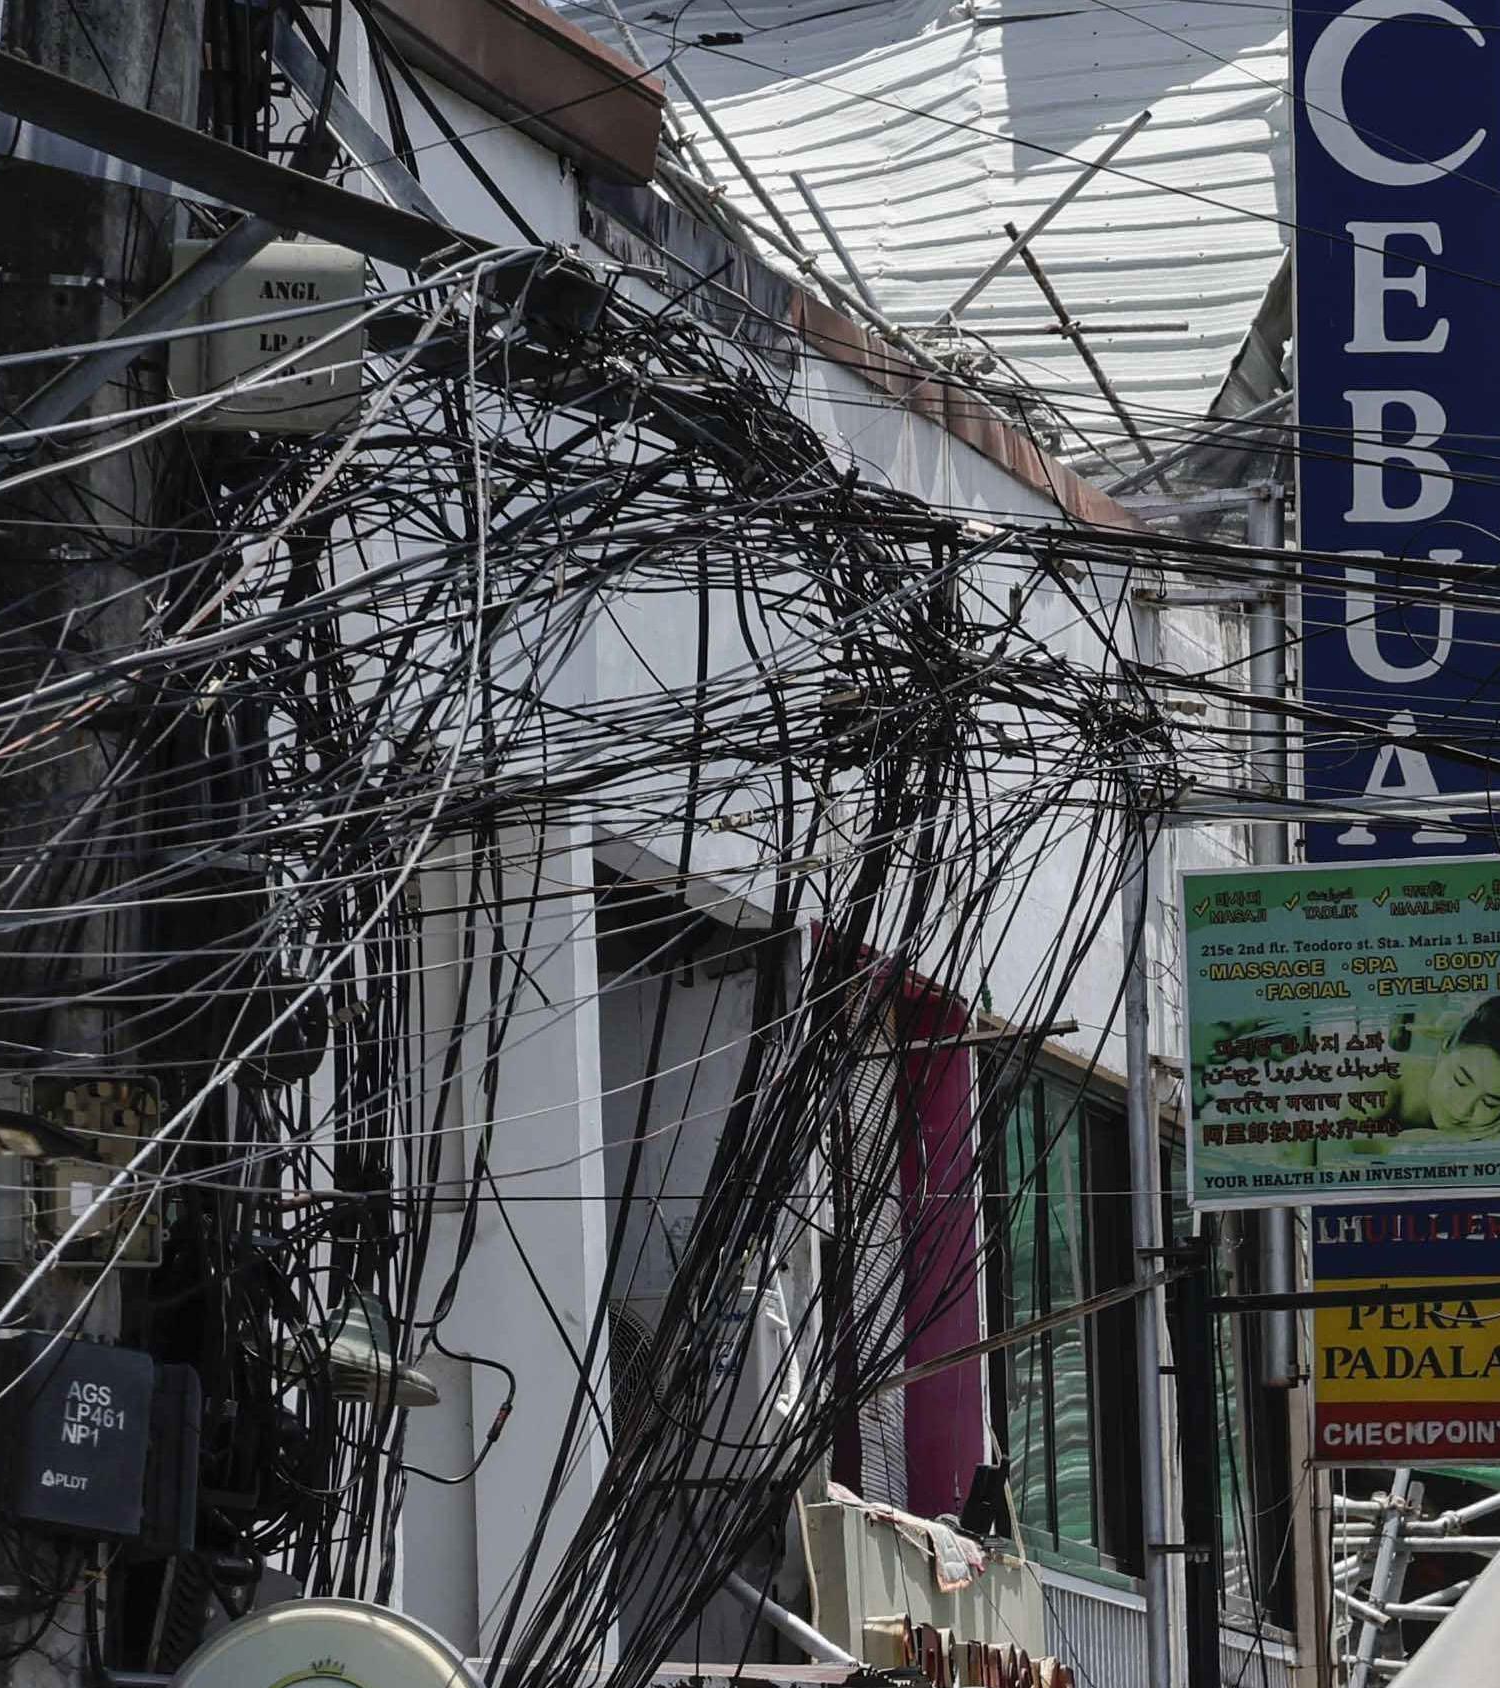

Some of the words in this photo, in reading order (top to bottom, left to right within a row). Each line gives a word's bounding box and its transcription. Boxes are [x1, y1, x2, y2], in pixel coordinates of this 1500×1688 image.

[1201, 943, 1233, 957] 215e
[1237, 942, 1265, 955] 2nd
[1294, 938, 1353, 953] Teodoro
[1378, 937, 1404, 949] Sta.
[1409, 933, 1451, 947] Maria
[1210, 960, 1325, 980] MASSAGE
[1352, 956, 1397, 975] SPA
[1434, 951, 1499, 971] BODY
[1266, 981, 1350, 1001] FACIAL
[1378, 974, 1489, 996] EYELASH
[1204, 1174, 1248, 1189] YOUR
[1252, 1171, 1315, 1187] HEALTH
[1319, 1170, 1335, 1184] IS
[1339, 1168, 1361, 1183] AN
[1365, 1162, 1470, 1182] INVESTMENT
[1347, 1298, 1488, 1332] PERA
[67, 1379, 112, 1406] AGS
[64, 1401, 125, 1431] LP461
[61, 1422, 99, 1448] NP1
[55, 1472, 88, 1491] PLDT
